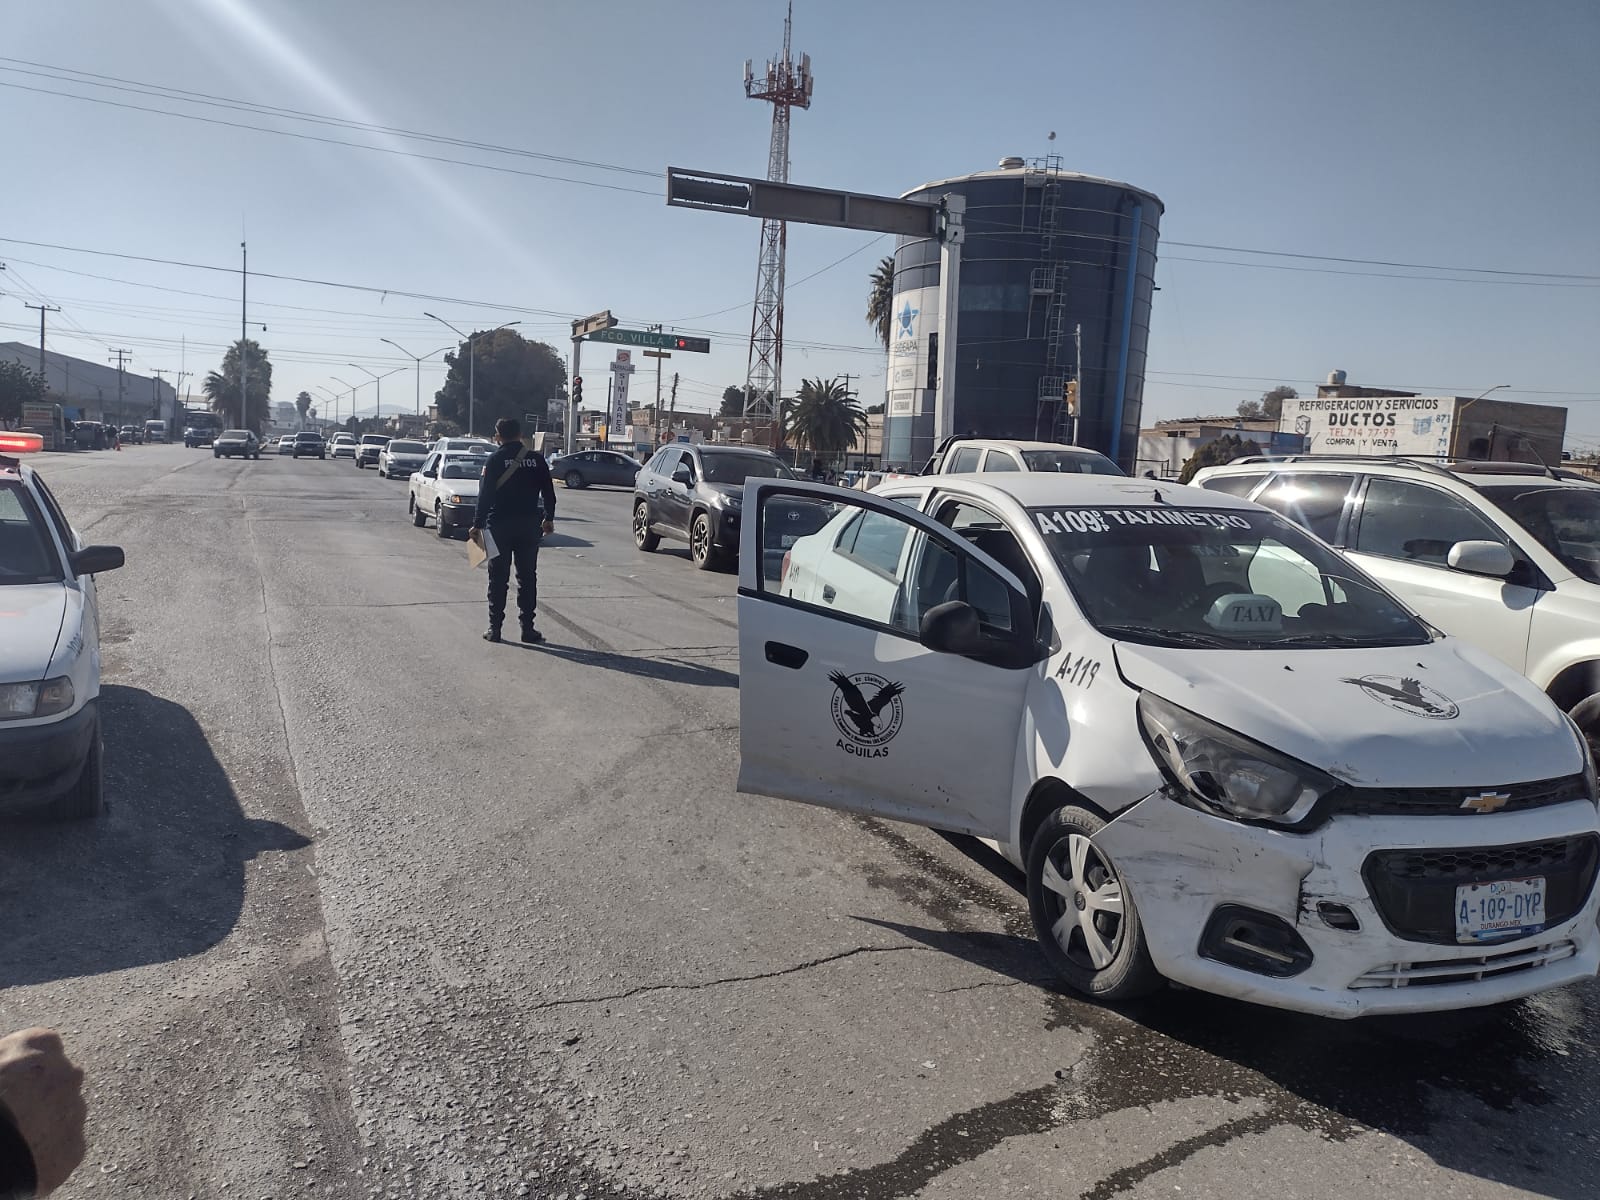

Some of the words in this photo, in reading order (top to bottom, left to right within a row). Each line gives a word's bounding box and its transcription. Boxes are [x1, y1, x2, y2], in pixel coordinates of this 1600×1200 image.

[601, 331, 626, 342] FCO.
[631, 334, 664, 346] VILLA
[615, 373, 625, 432] SIMILARES
[1299, 400, 1374, 412] REFRIGERACION
[1375, 400, 1384, 410] Y
[1385, 399, 1439, 410] SERVICIOS
[1328, 412, 1397, 427] DUCTOS
[1435, 414, 1451, 423] 871
[1325, 438, 1355, 446] COMPRA
[1361, 438, 1368, 446] Y
[1372, 438, 1398, 448] VENTA
[1035, 510, 1102, 535] A109
[1104, 510, 1252, 530] TAXIMETRO
[1233, 606, 1276, 622] TAXI
[1055, 651, 1101, 690] A-119
[836, 739, 889, 758] AGUILAS
[1459, 892, 1541, 924] A-109-DYP
